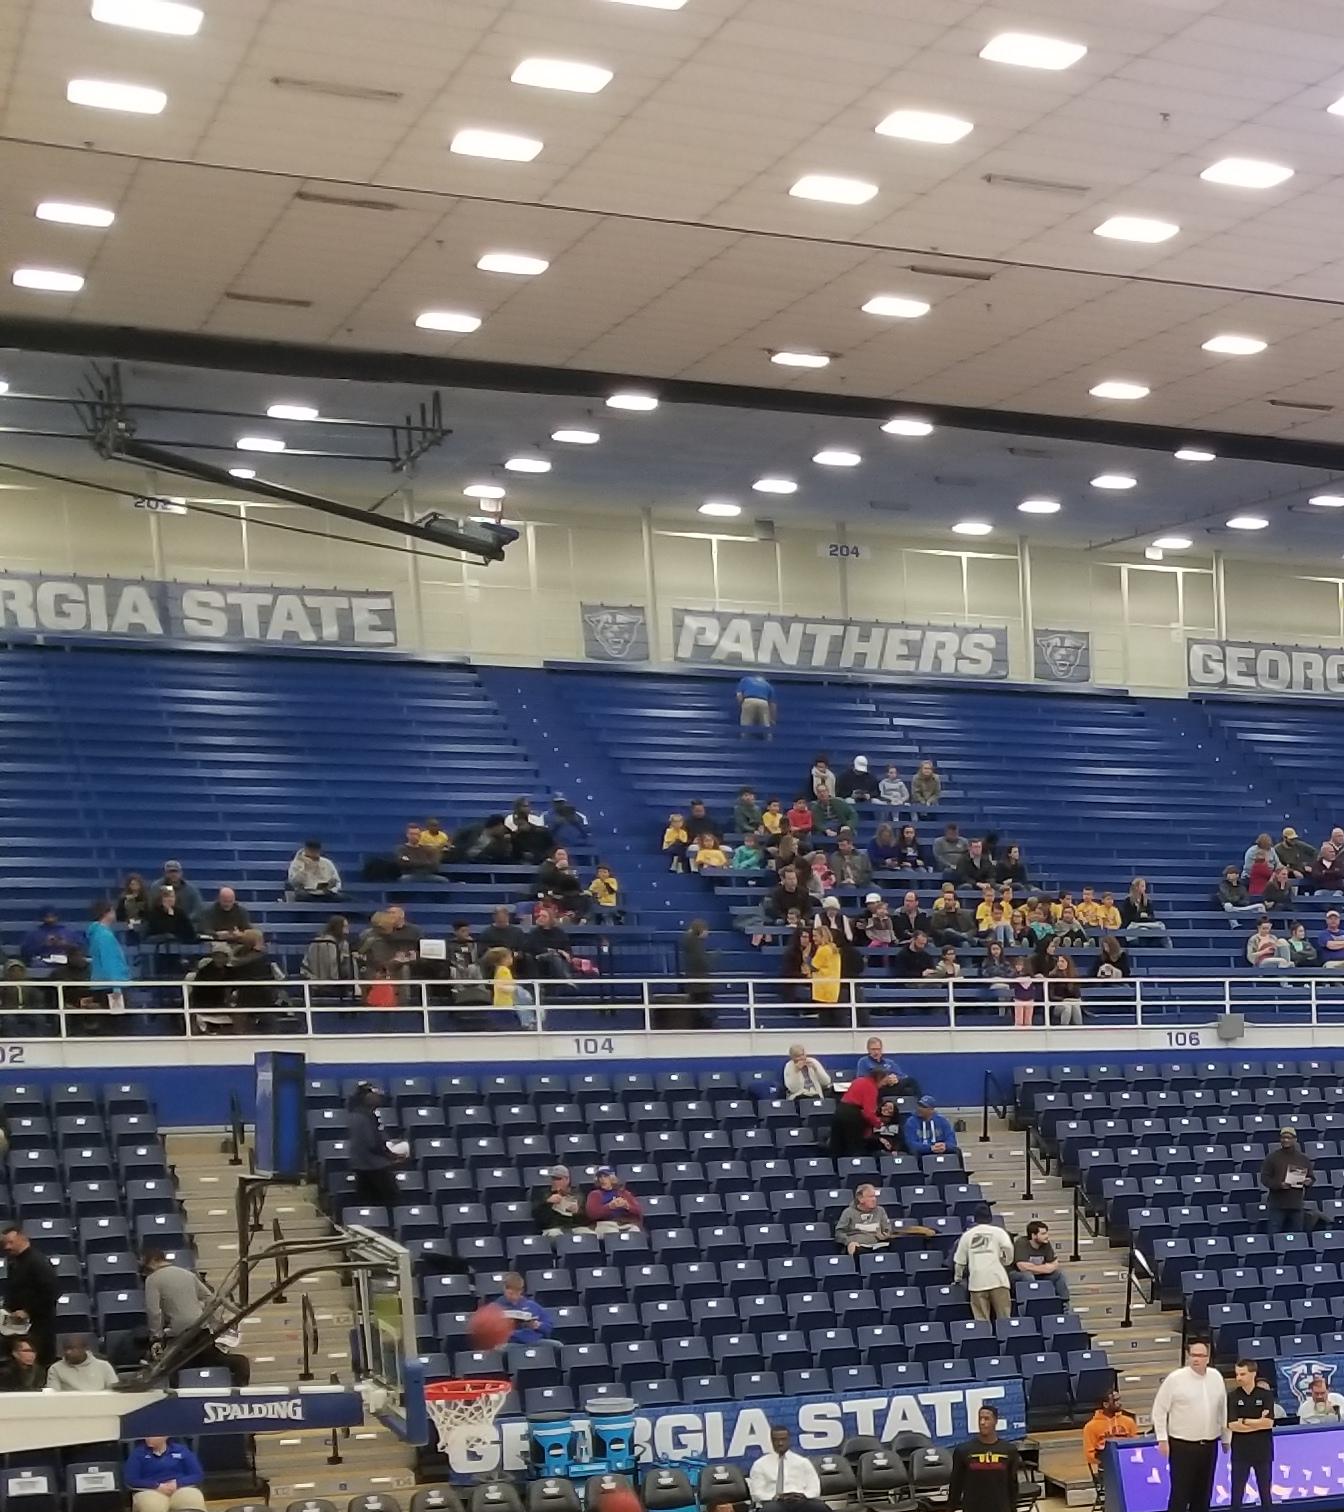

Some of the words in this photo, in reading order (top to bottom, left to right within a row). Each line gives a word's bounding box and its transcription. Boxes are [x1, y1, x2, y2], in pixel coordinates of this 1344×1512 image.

[827, 544, 861, 558] 204
[181, 588, 395, 644] STATE
[676, 614, 998, 676] PANTHERS
[573, 1037, 615, 1056] 104
[1165, 1030, 1201, 1048] 106
[203, 1398, 305, 1424] SPALDING
[797, 1386, 1008, 1451] STATE
